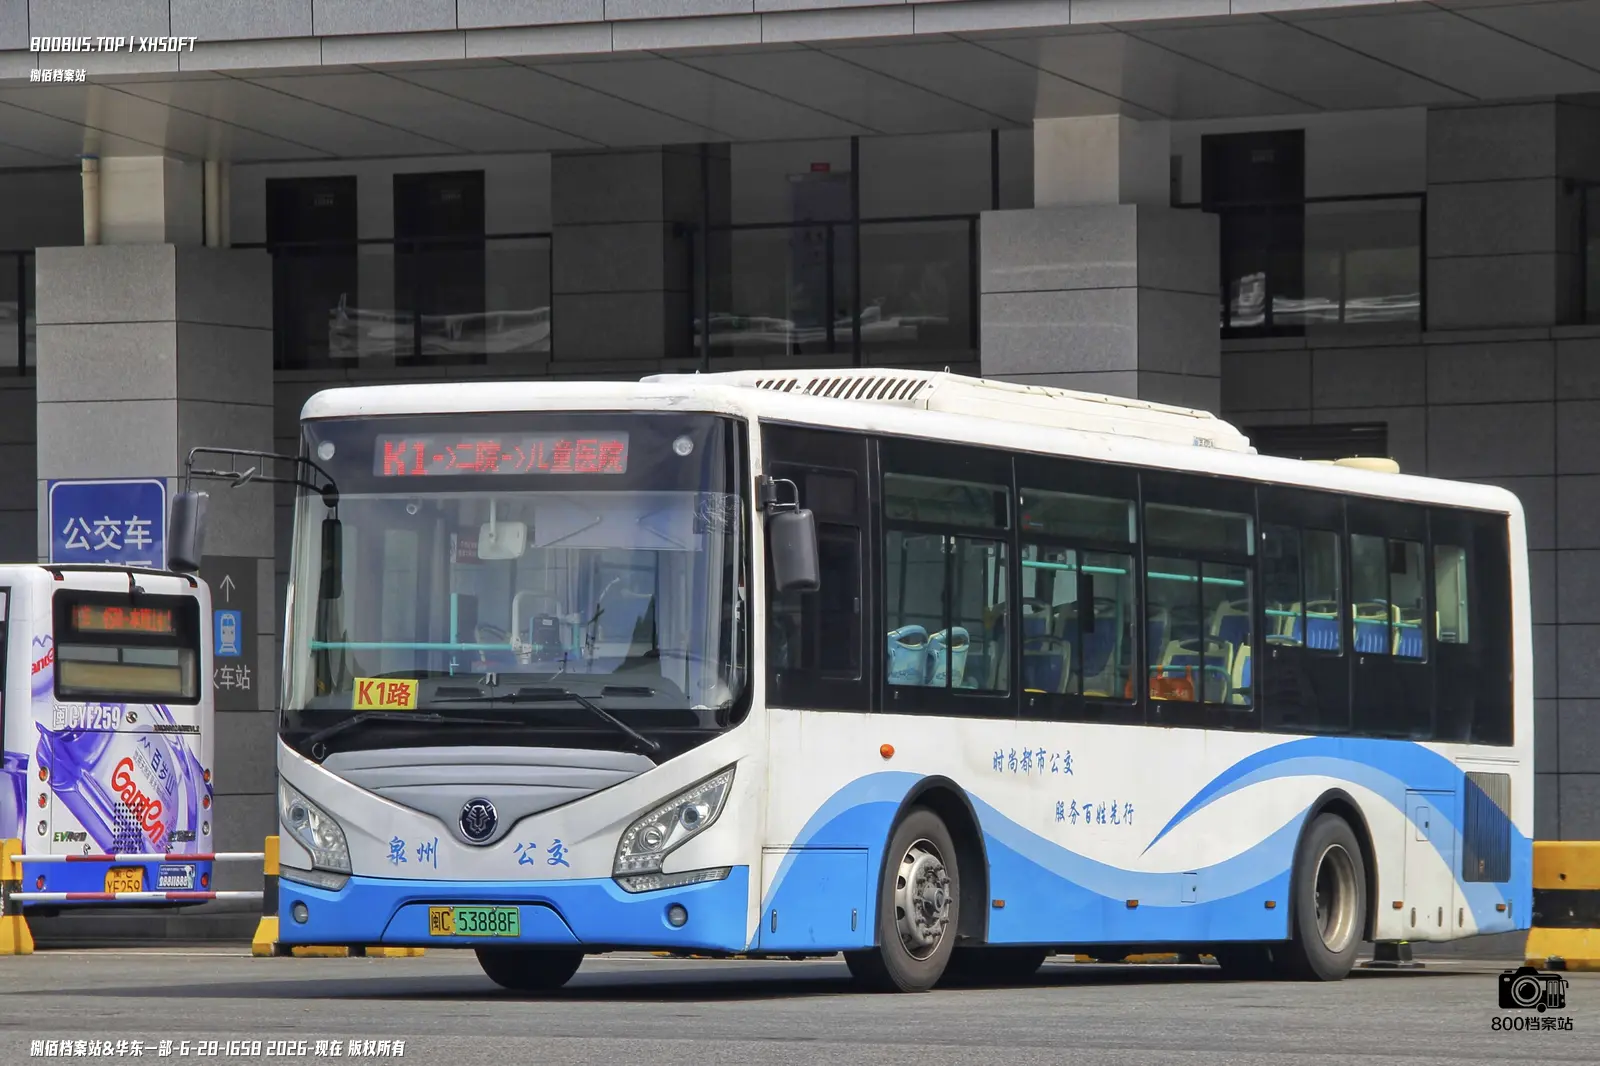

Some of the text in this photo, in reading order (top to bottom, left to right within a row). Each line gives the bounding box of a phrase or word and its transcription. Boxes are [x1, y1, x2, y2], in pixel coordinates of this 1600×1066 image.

[62, 515, 153, 551] 公交车
[358, 681, 411, 706] K1路
[53, 703, 121, 729] 闽CYF259
[992, 747, 1075, 776] 时尚都市公交
[1055, 799, 1135, 826] 服务百姓先行
[386, 836, 570, 869] 泉州 公交
